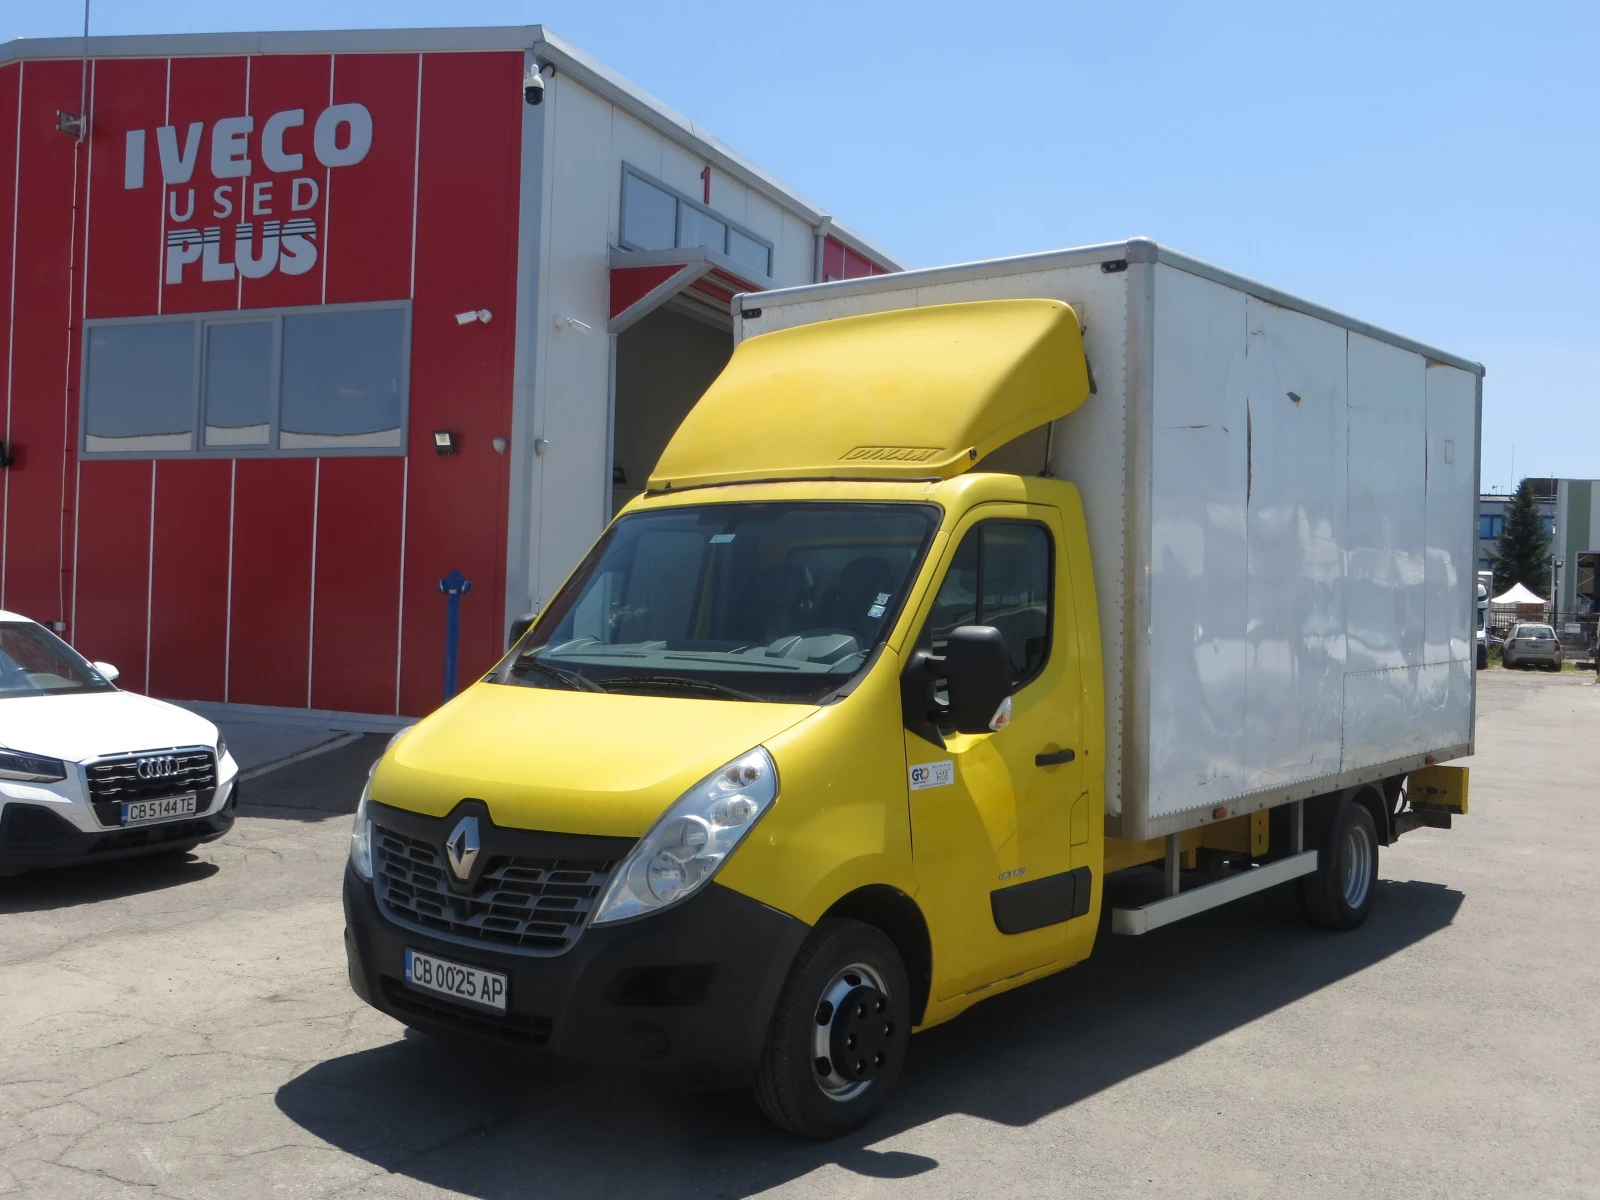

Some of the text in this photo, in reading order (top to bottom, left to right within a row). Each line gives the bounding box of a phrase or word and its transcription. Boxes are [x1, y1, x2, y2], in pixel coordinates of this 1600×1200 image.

[124, 102, 374, 190] IVECO
[169, 177, 319, 223] USED
[700, 166, 711, 205] 1
[166, 217, 318, 285] PLUS
[130, 804, 146, 820] CB
[149, 800, 178, 817] 5144
[180, 797, 194, 812] TE
[414, 956, 433, 985] CB
[436, 964, 477, 997] 0025
[480, 975, 503, 1003] AP
